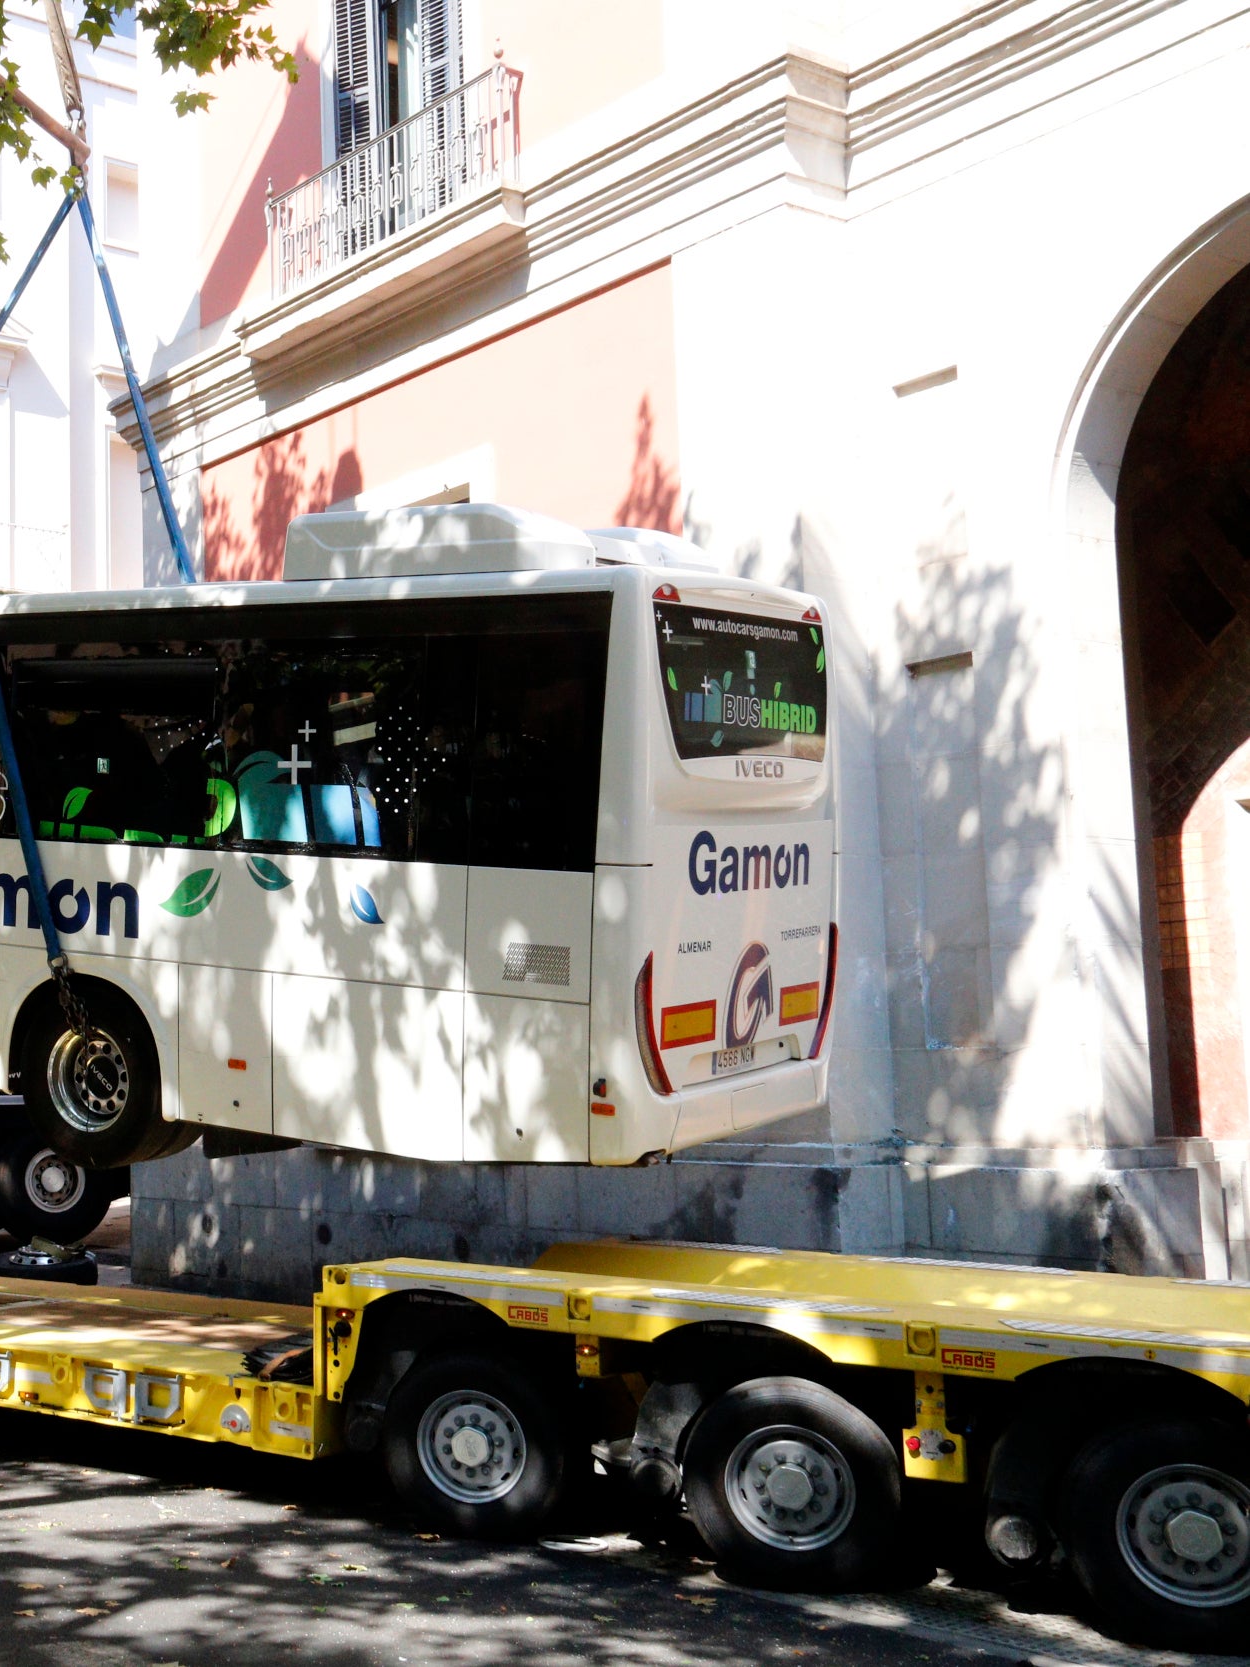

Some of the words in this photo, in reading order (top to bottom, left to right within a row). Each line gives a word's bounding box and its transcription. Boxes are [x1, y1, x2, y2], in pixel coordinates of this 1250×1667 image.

[692, 617, 799, 642] www.autocarsgamon.com
[735, 760, 784, 778] IVECO
[781, 925, 822, 941] TORREFARRERA
[677, 940, 712, 954] ALMENAR
[90, 1063, 113, 1092] IVECO
